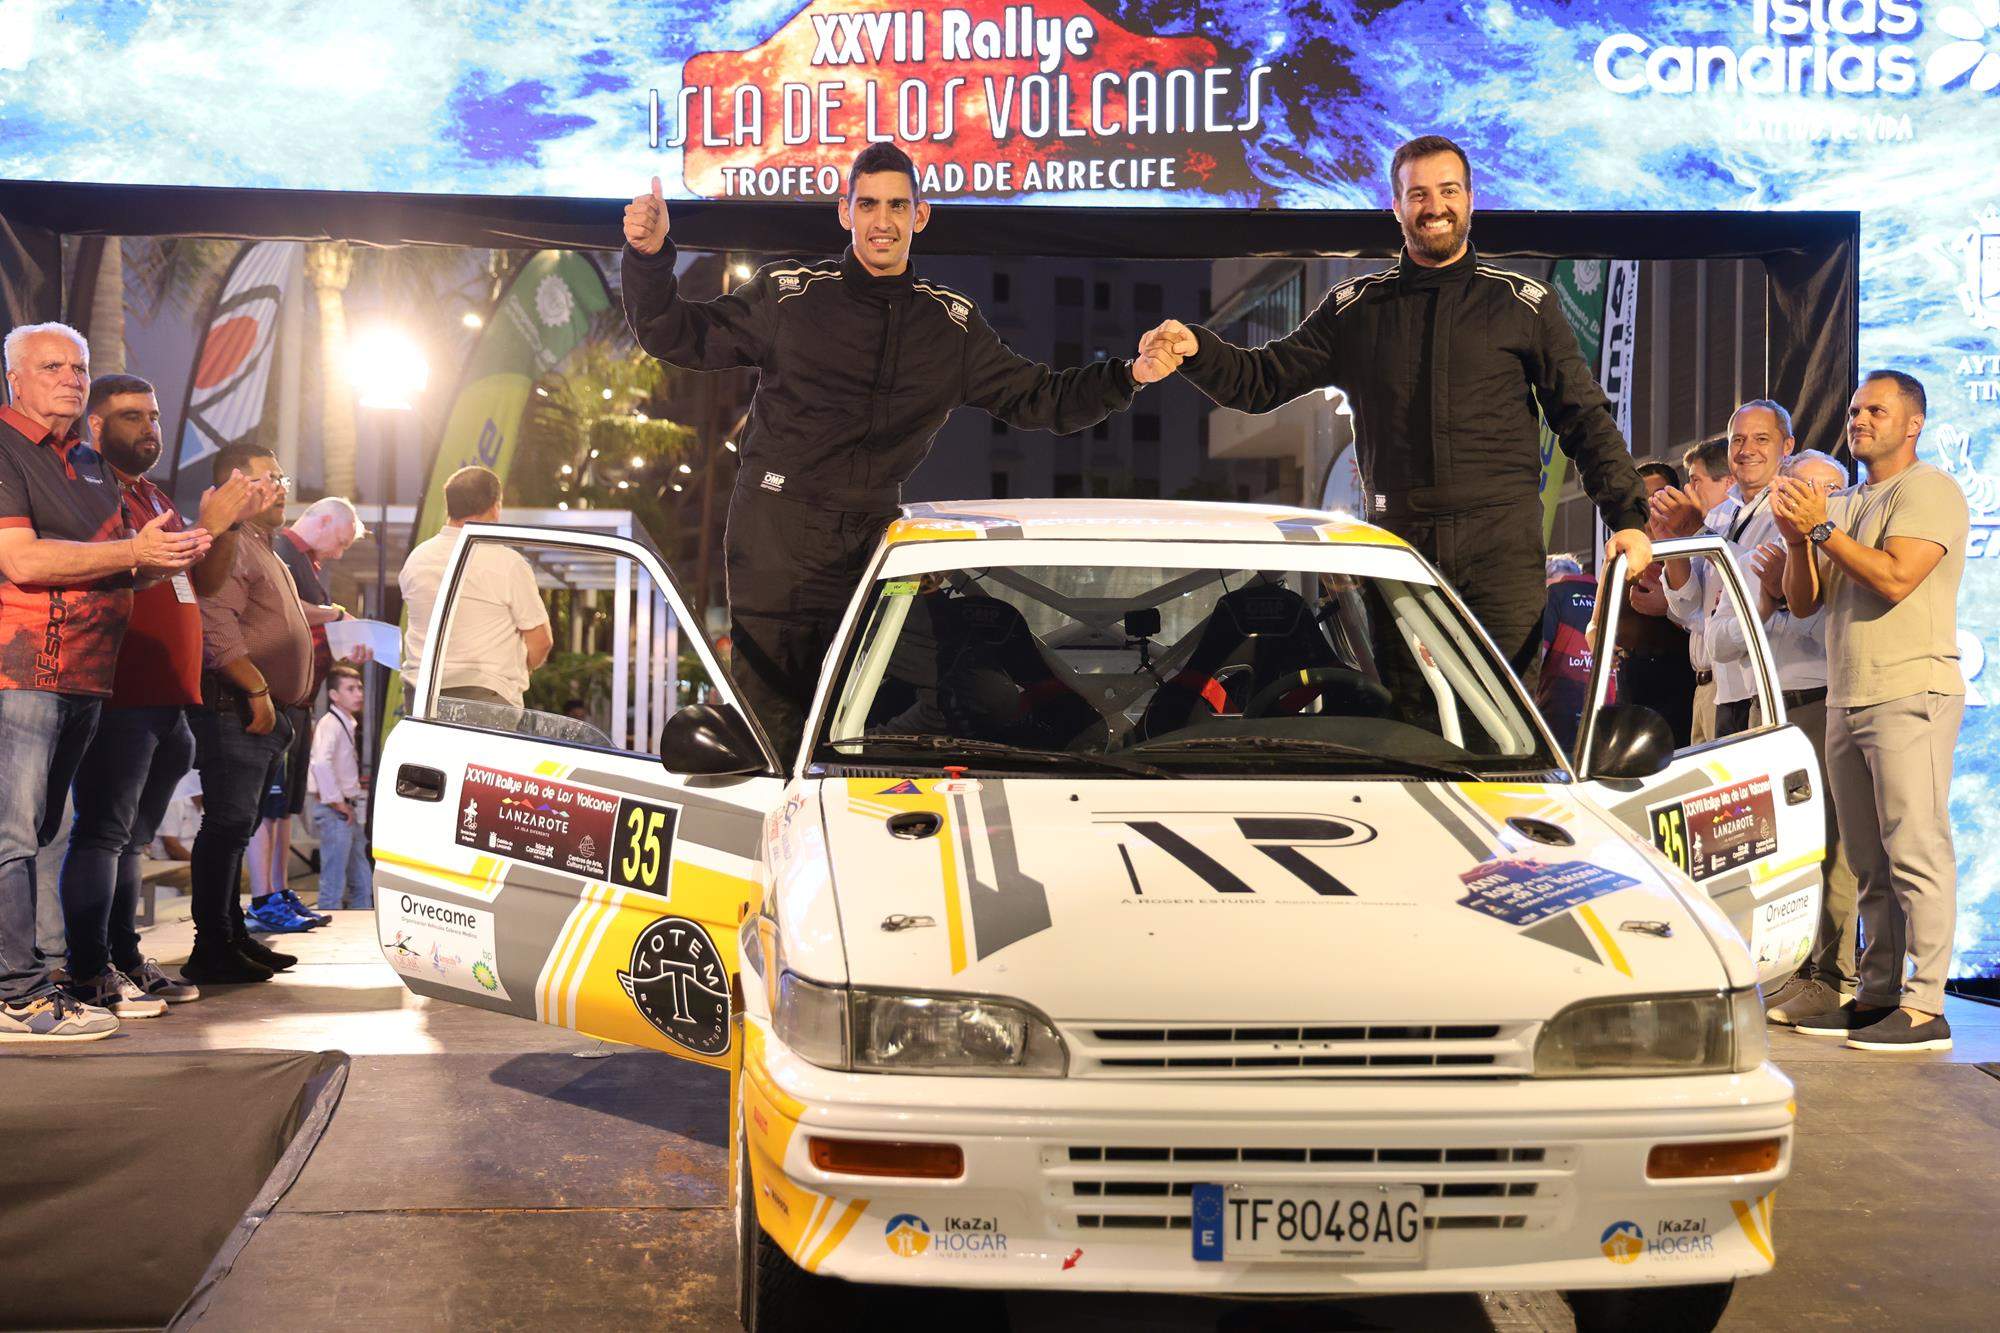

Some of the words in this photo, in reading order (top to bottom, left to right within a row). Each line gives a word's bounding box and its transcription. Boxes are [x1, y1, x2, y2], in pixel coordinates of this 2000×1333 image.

[1753, 0, 1917, 34] Islas
[810, 12, 924, 64] XXVII
[942, 8, 1094, 72] Rallye
[1593, 33, 1916, 93] Canarias
[649, 83, 762, 148] ISLA
[784, 81, 845, 145] DE
[866, 77, 965, 143] LOS
[985, 66, 1271, 139] VOLCANES
[1861, 113, 1913, 141] VIDA
[723, 164, 834, 196] TROFEO
[973, 163, 1011, 191] DE
[1024, 158, 1176, 190] ARRECIFE
[778, 277, 800, 285] OMP
[951, 301, 969, 316] OMP
[764, 474, 785, 487] OMP
[465, 767, 495, 787] XXVII
[495, 773, 522, 793] Rallye
[542, 784, 555, 799] de
[558, 788, 573, 803] Los
[577, 792, 618, 814] Volcanes
[498, 807, 570, 834] LANZAROTE
[1713, 814, 1754, 839] LANZAROTE
[622, 806, 666, 887] 35
[1658, 809, 1685, 872] 35
[401, 894, 476, 929] Orvecame
[1766, 894, 1809, 923] Orvecame
[638, 928, 720, 987] TOTEM
[702, 1003, 723, 1047] STUDIO
[945, 1217, 998, 1233] [KaZa]
[1228, 1198, 1418, 1244] TF8048AG
[1657, 1218, 1707, 1236] [KaZa]
[934, 1233, 1008, 1252] HOGAR
[1201, 1230, 1215, 1247] E
[1647, 1234, 1714, 1256] HOGAR
